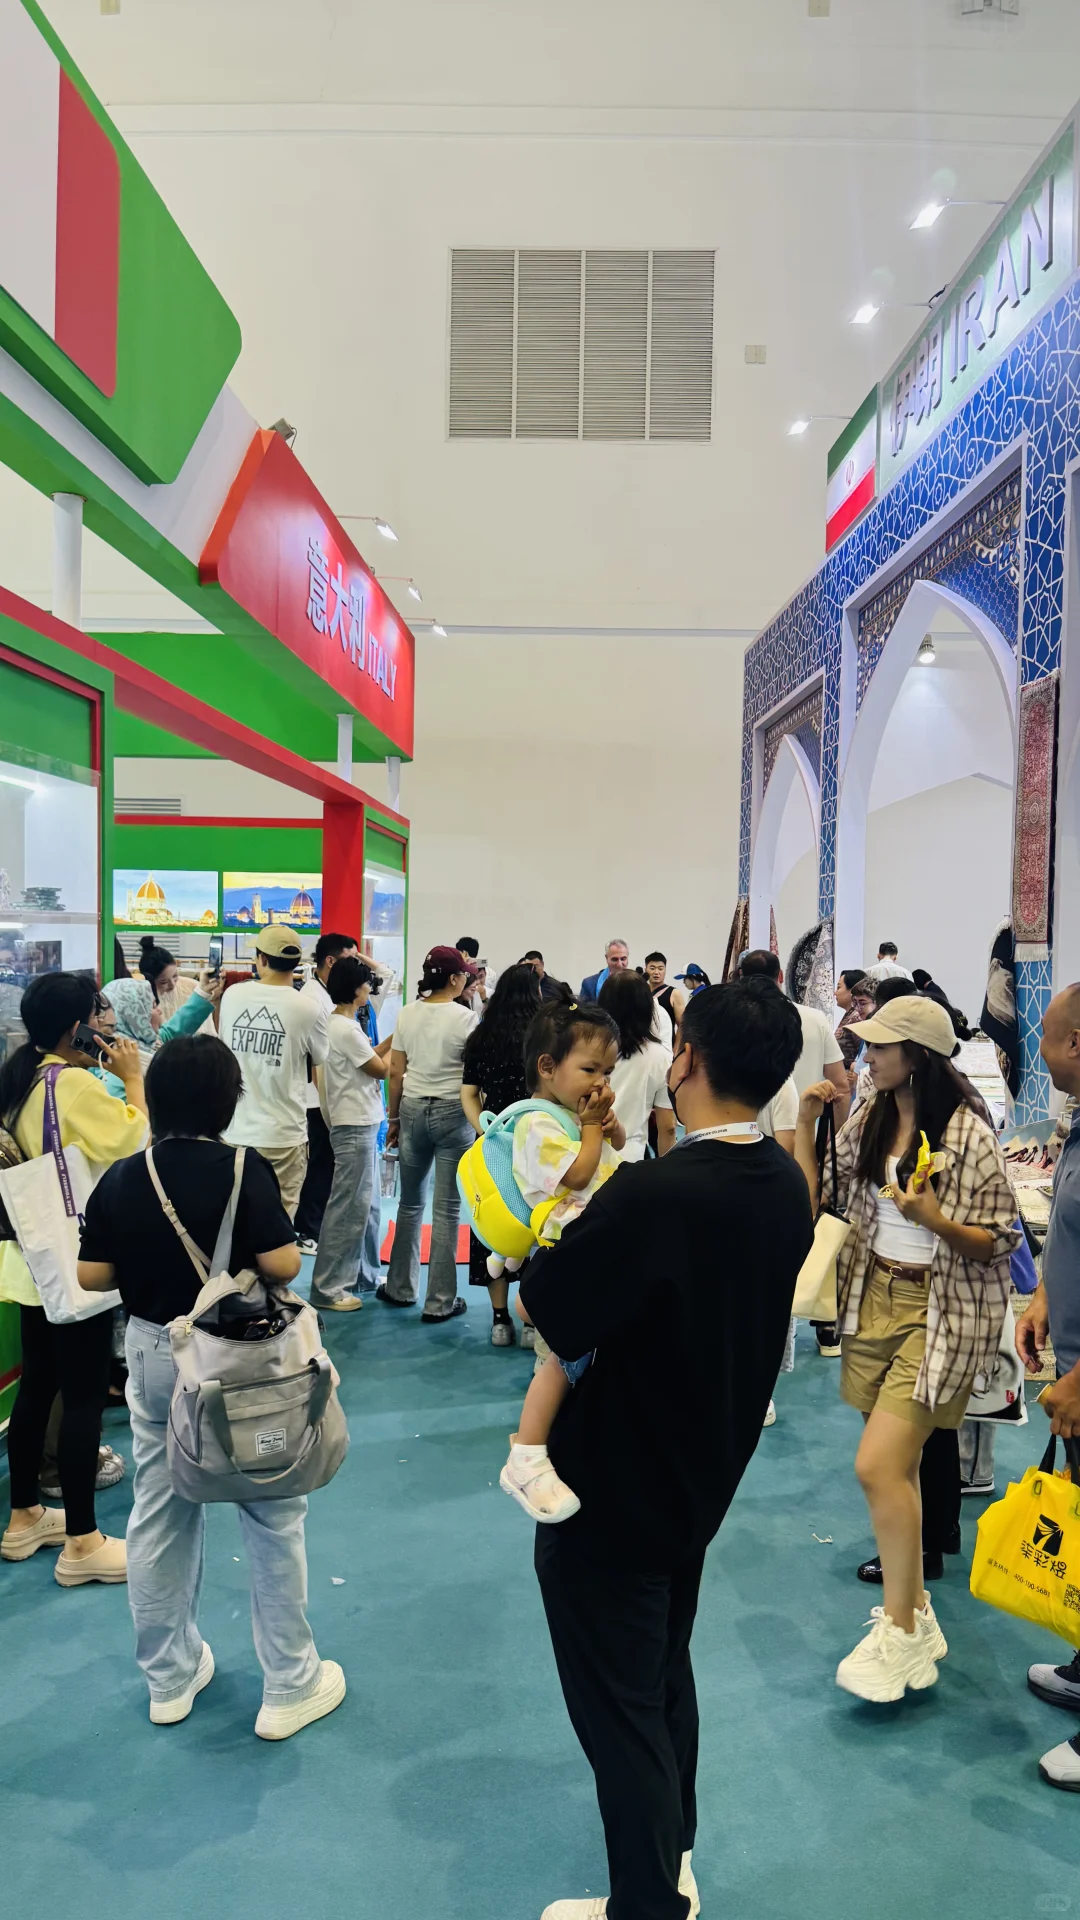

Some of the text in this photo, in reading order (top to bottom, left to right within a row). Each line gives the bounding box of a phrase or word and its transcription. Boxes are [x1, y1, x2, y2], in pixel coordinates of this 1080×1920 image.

[890, 173, 1054, 458] 伊朗 IRAN
[306, 537, 397, 702] 意大利 ITALY
[231, 1028, 286, 1057] EXPLORE
